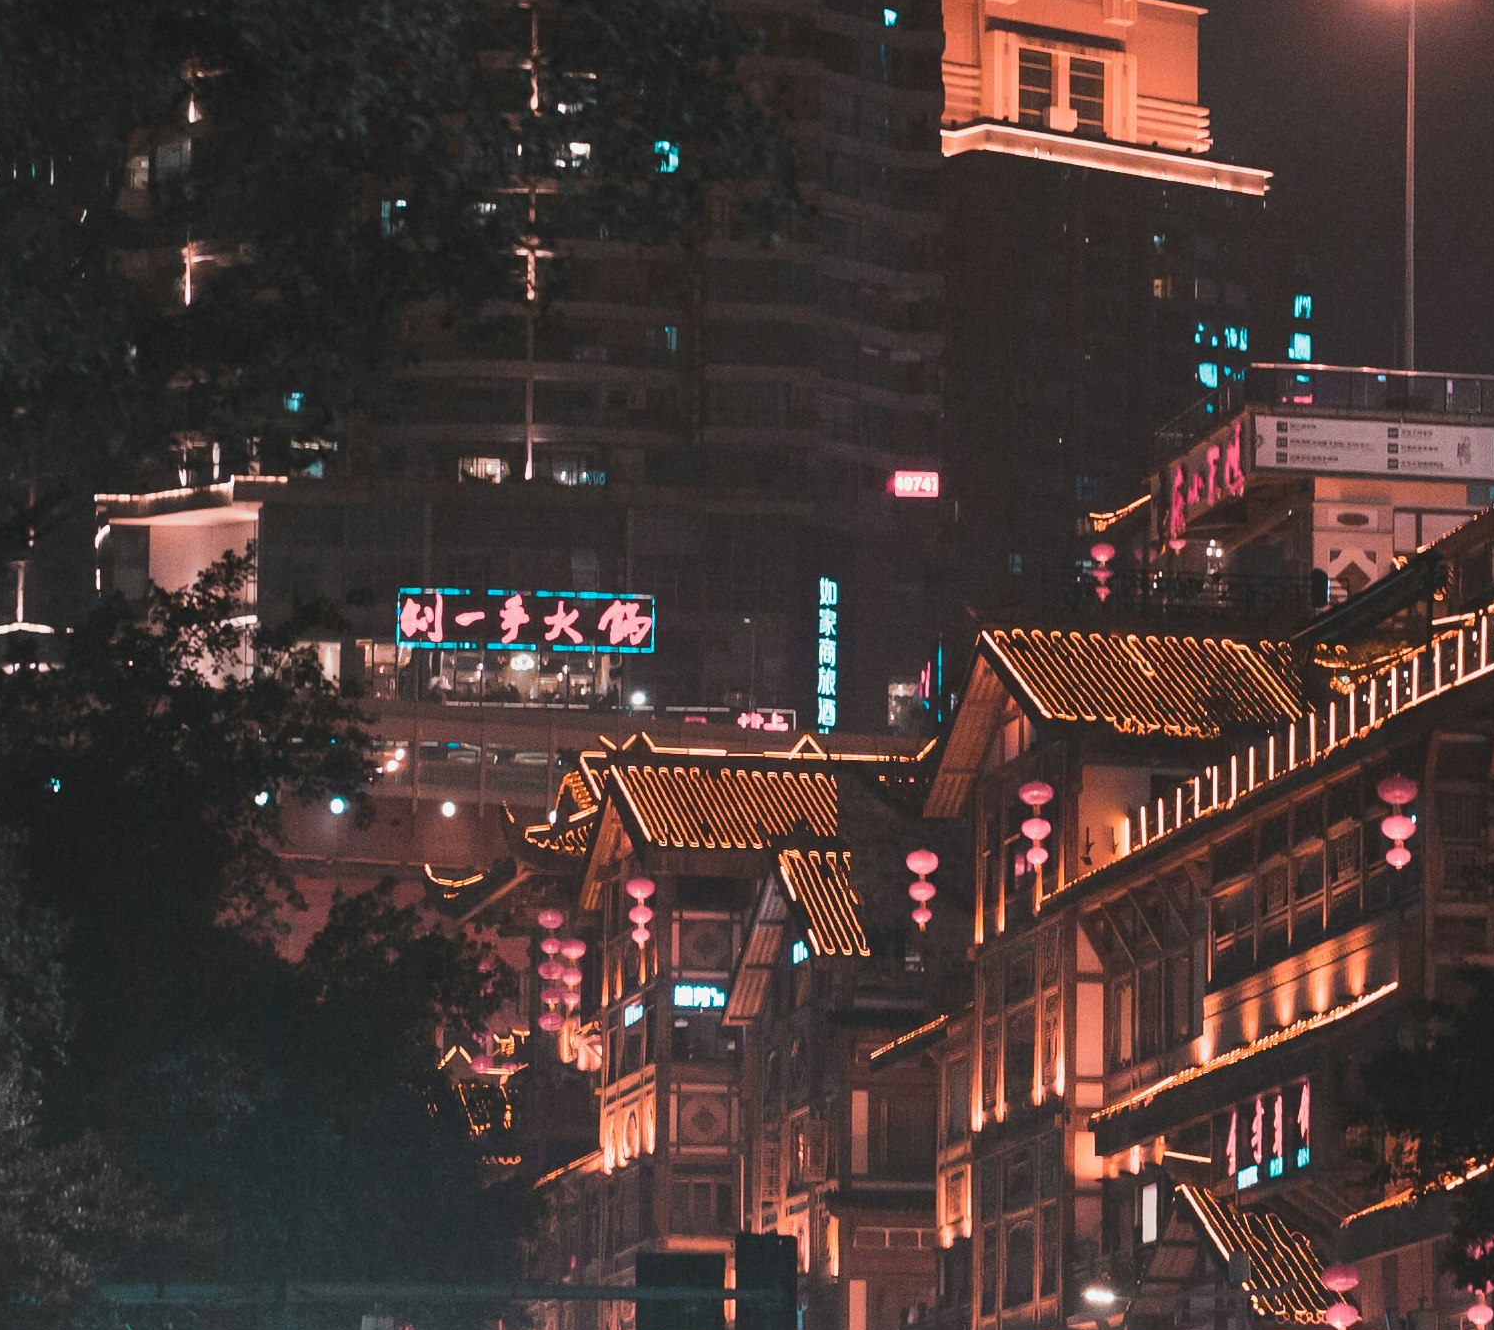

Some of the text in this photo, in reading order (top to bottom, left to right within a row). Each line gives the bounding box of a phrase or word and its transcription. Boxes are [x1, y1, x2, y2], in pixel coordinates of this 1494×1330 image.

[817, 576, 838, 734] 如家商旅酒
